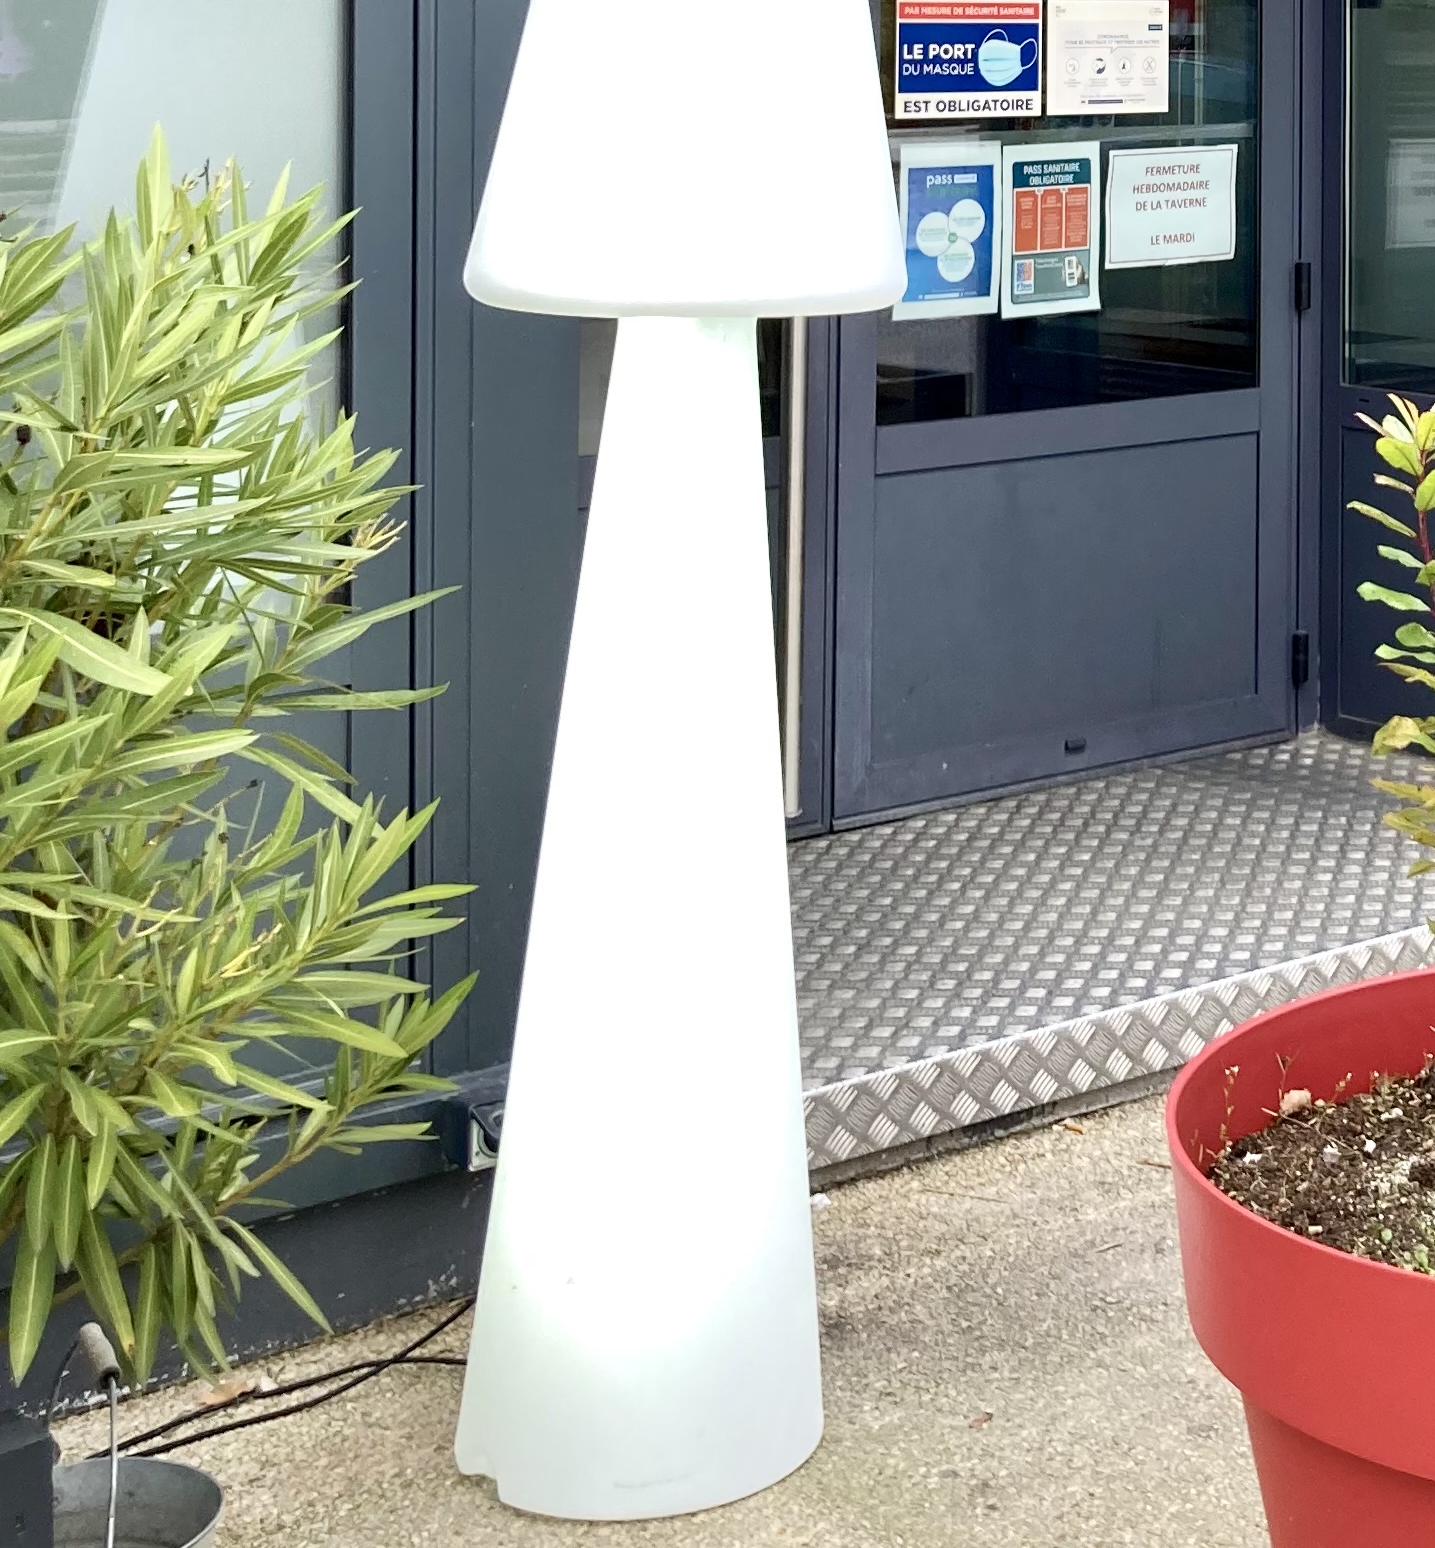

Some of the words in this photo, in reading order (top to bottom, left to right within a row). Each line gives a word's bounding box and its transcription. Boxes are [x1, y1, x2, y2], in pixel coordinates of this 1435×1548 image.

[905, 6, 919, 15] PAR
[921, 6, 951, 16] MESURE
[952, 6, 963, 16] DE
[965, 5, 998, 16] SÉCURITÉ
[999, 7, 1035, 16] SANITAIRE
[903, 44, 924, 60] LE
[928, 44, 975, 60] PORT
[902, 64, 920, 76] DU
[923, 63, 974, 76] MASQUE
[903, 100, 931, 113] EST
[935, 98, 1034, 113] OBLIGATOIRE
[1023, 164, 1042, 175] PASS
[1043, 162, 1080, 174] SANITAIRE
[1145, 163, 1201, 177] FERMETURE
[926, 173, 953, 189] pass
[1029, 174, 1074, 186] OBLIGATOIRE
[1132, 180, 1210, 195] HEBDOMADAIRE
[1135, 200, 1148, 212] DE
[1150, 200, 1162, 211] LA
[1164, 197, 1207, 210] TAVERNE
[1150, 234, 1160, 246] LE
[1163, 232, 1195, 245] MARDI
